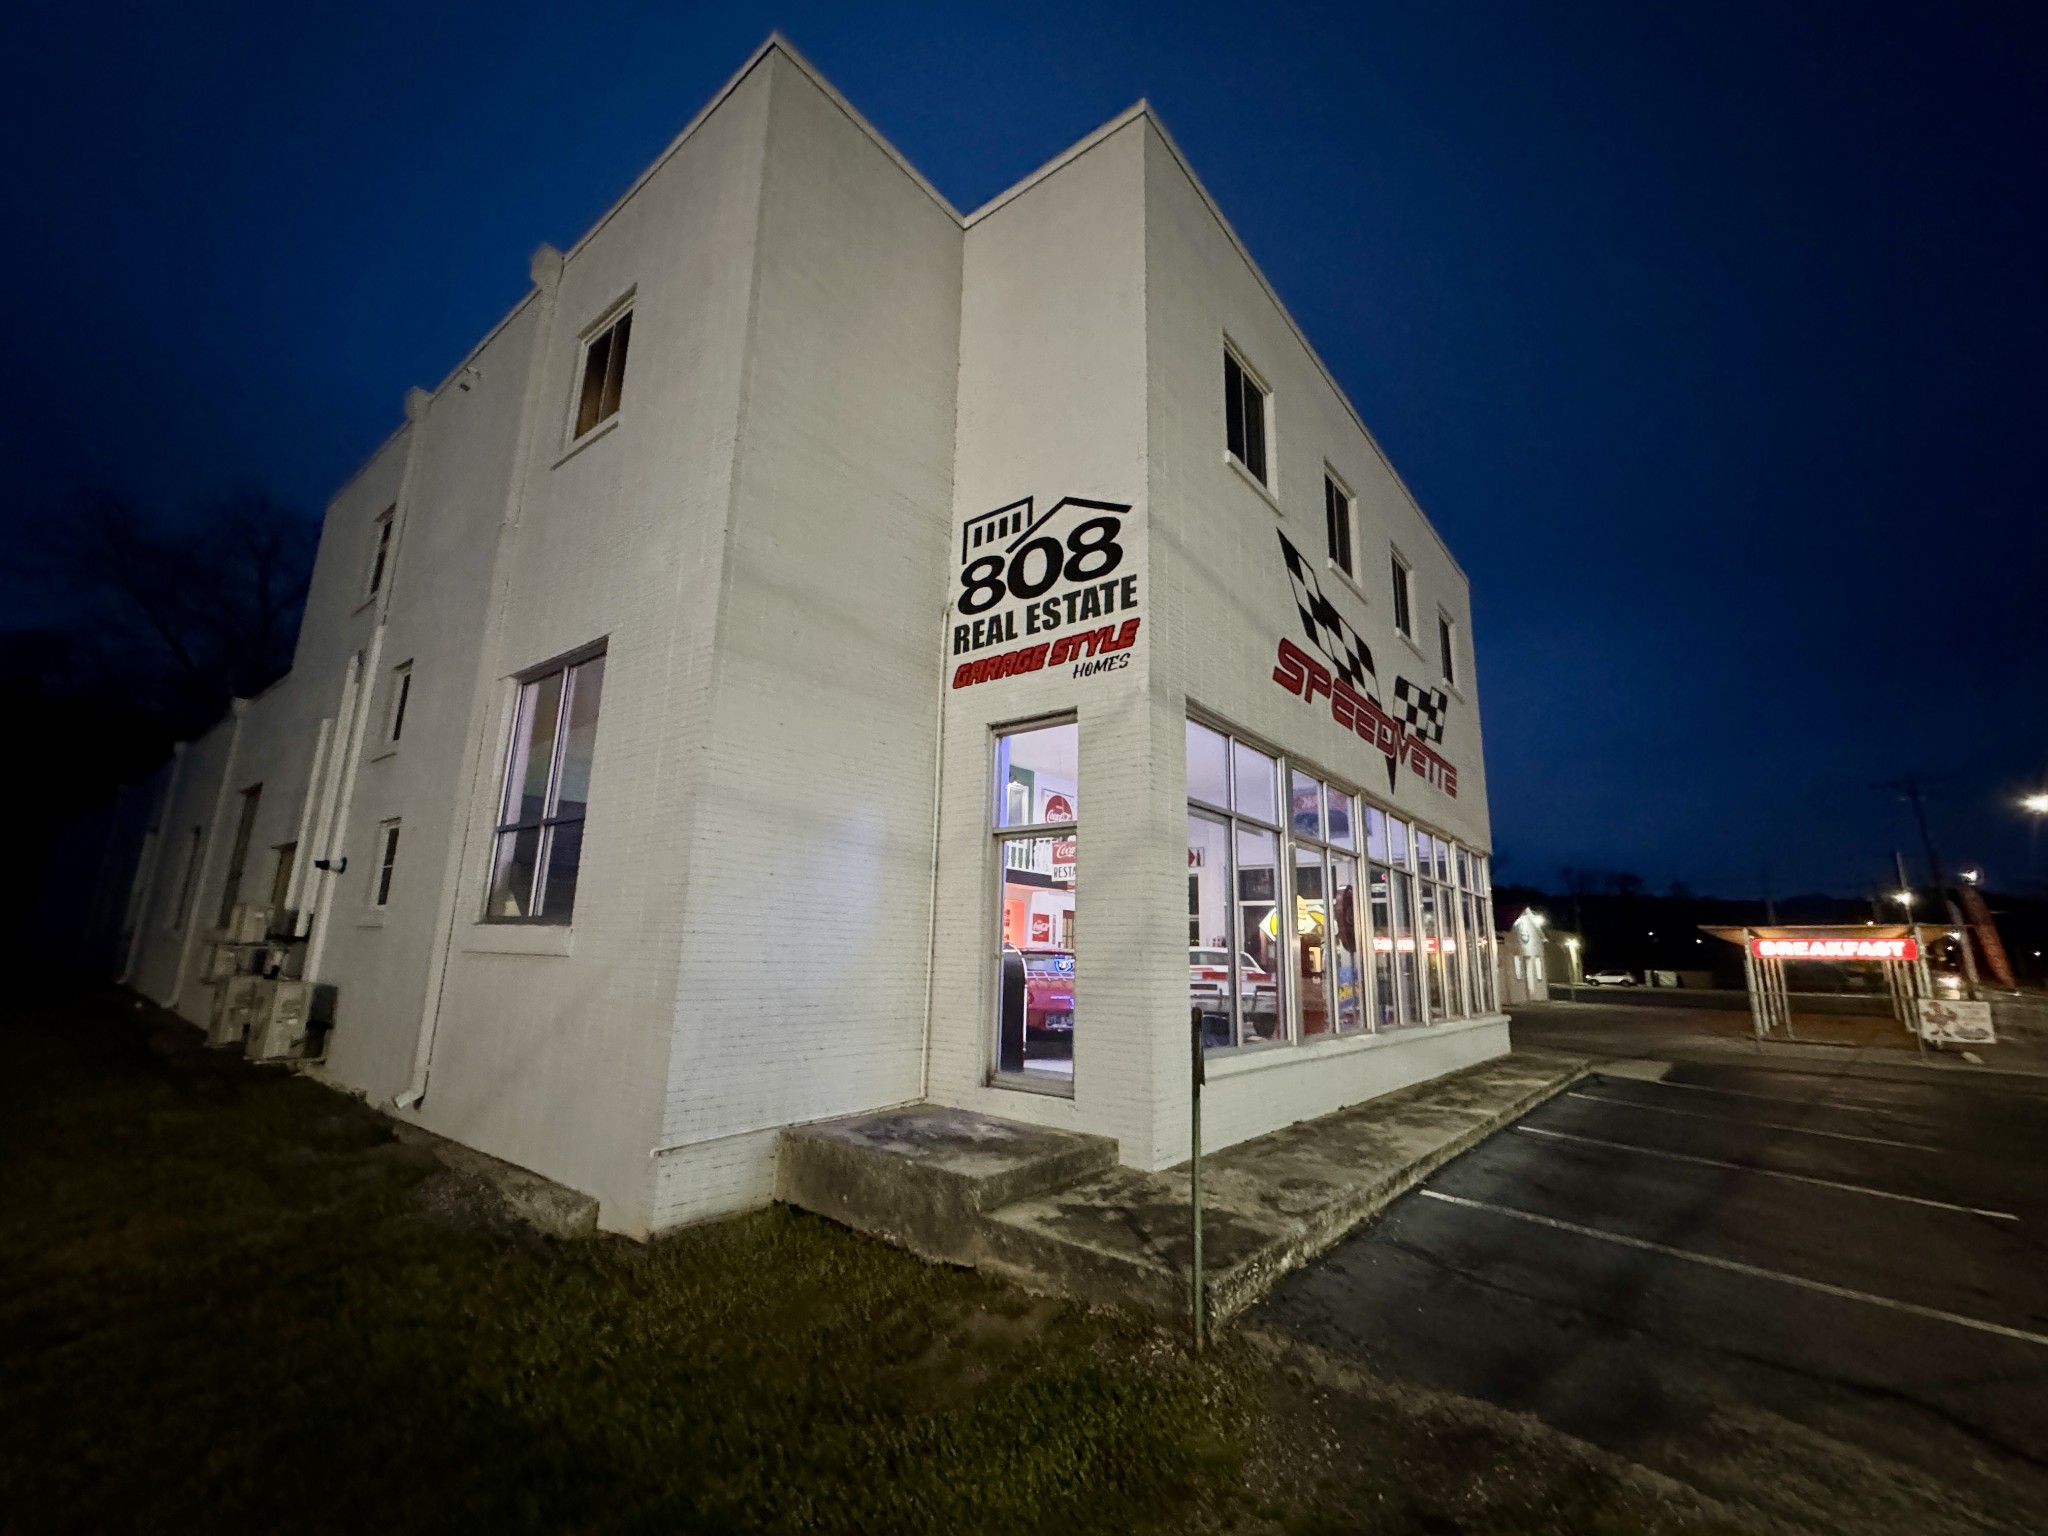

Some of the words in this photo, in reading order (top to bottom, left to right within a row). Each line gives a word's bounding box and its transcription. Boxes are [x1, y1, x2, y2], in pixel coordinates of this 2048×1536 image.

[957, 516, 1124, 616] 808
[953, 610, 1018, 656] REAL
[1026, 573, 1138, 636] ESTATE
[952, 642, 1051, 690] GARAGE
[1047, 617, 1141, 667] STYLE
[1073, 652, 1131, 679] HOMES
[1758, 940, 1906, 958] BREAKFAST
